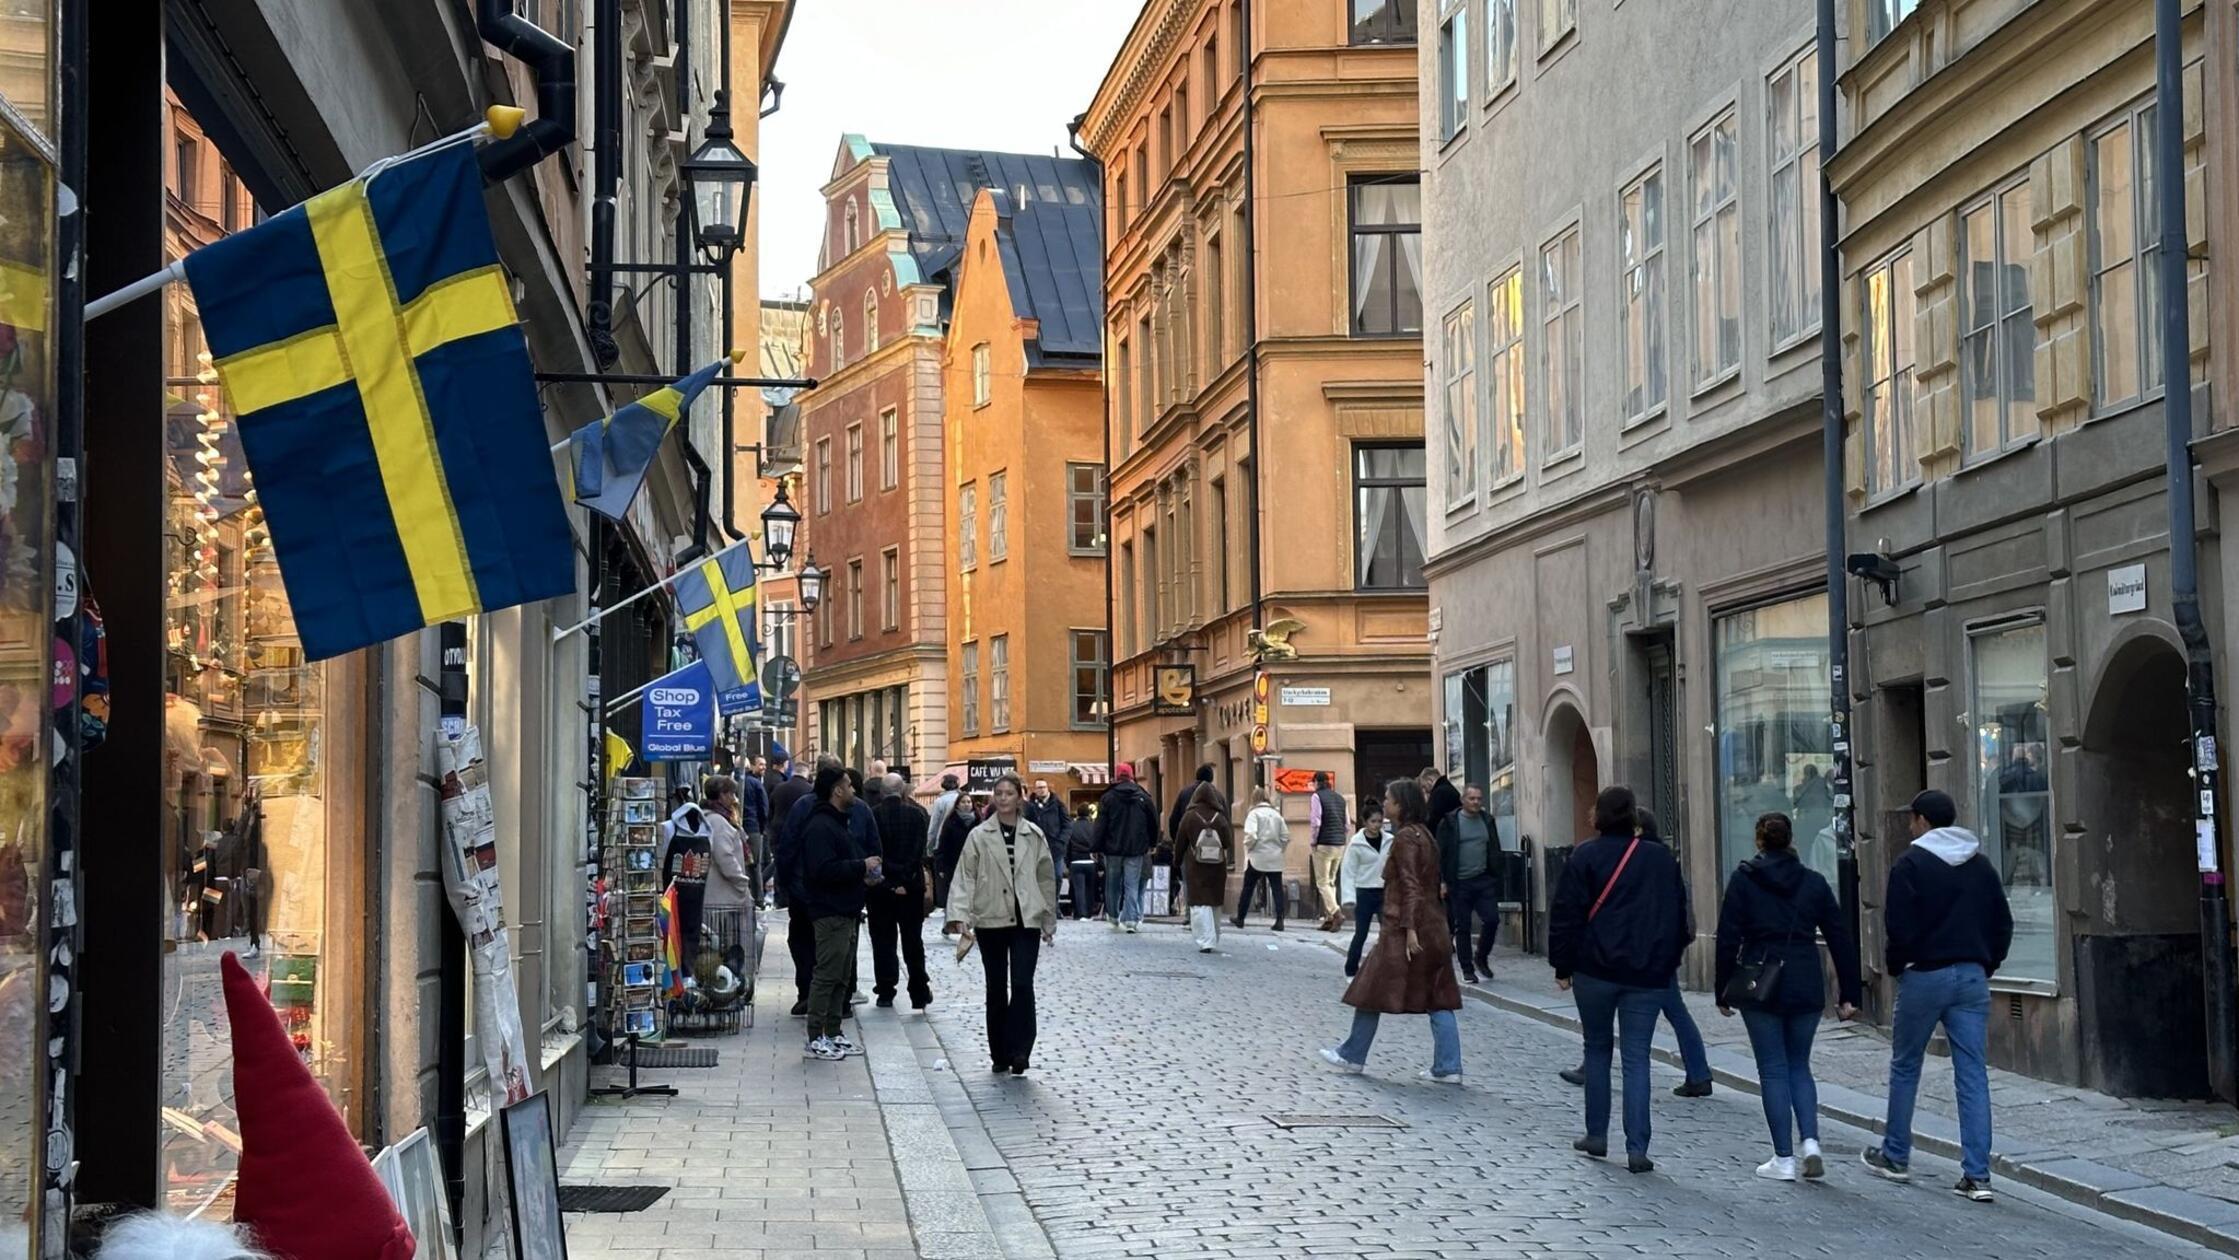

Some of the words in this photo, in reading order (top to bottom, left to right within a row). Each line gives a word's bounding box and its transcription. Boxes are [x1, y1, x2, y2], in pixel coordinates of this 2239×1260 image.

[654, 690, 695, 703] Shop
[725, 692, 748, 701] Free
[654, 706, 682, 718] Tax
[657, 720, 692, 731] Free
[648, 744, 681, 752] Global
[683, 744, 705, 752] Blue
